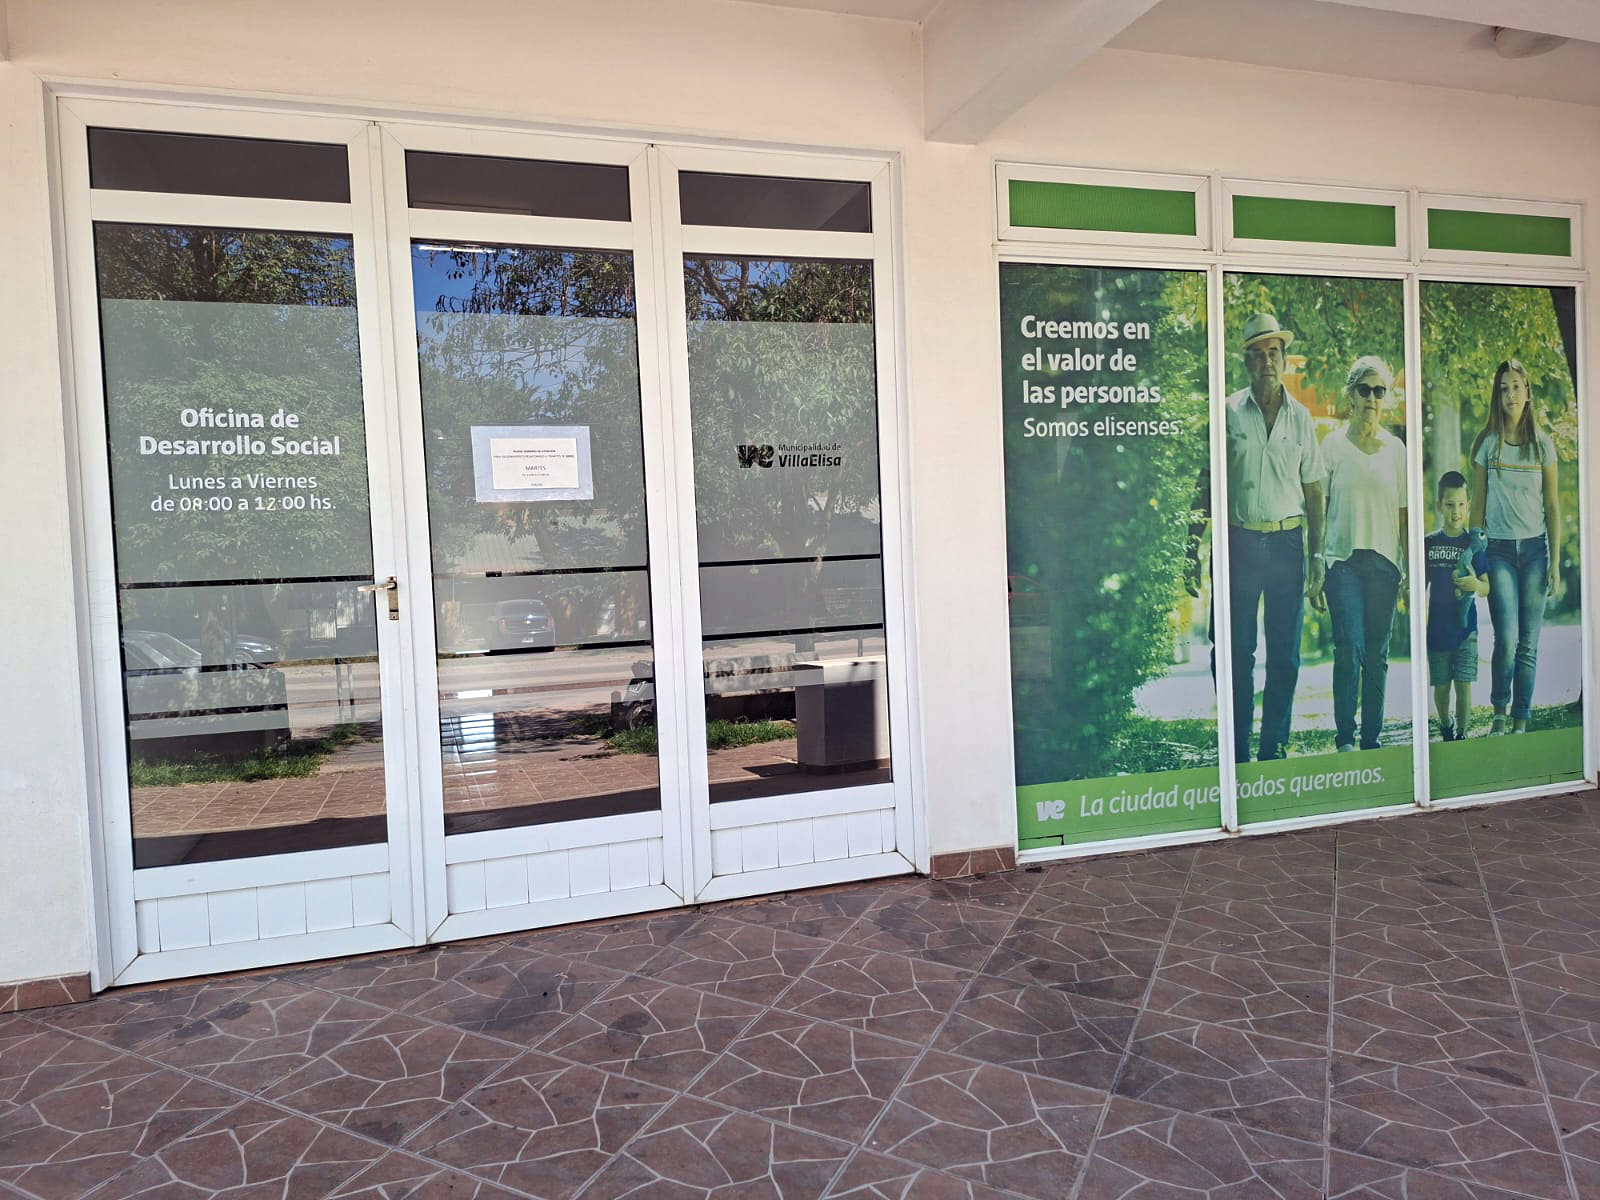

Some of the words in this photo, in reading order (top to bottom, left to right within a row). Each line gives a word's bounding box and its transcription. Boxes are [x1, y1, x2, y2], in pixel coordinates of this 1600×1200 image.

[1020, 315, 1118, 339] Creemos
[1123, 321, 1150, 339] en
[1021, 347, 1042, 371] el
[1047, 347, 1104, 371] valor
[1109, 348, 1136, 371] de
[1023, 380, 1055, 403] las
[180, 407, 264, 428] Oficina
[270, 409, 299, 428] de
[1023, 417, 1089, 437] Somos
[1093, 416, 1184, 437] elisenses.
[139, 435, 266, 455] Desarrollo
[271, 436, 340, 455] Social
[778, 443, 831, 452] Municipalidad
[831, 442, 841, 451] de
[778, 454, 841, 467] VillaElisa
[168, 474, 226, 489] Lunes
[231, 477, 242, 489] a
[247, 473, 317, 489] Viernes
[151, 496, 175, 511] de
[180, 497, 233, 511] 08:00
[238, 499, 249, 510] a
[255, 496, 305, 511] 12:00
[310, 494, 336, 510] hs.
[1080, 795, 1103, 817] La
[1109, 784, 1178, 813] ciudad
[1183, 785, 1220, 810] que
[1290, 767, 1385, 797] queremos.
